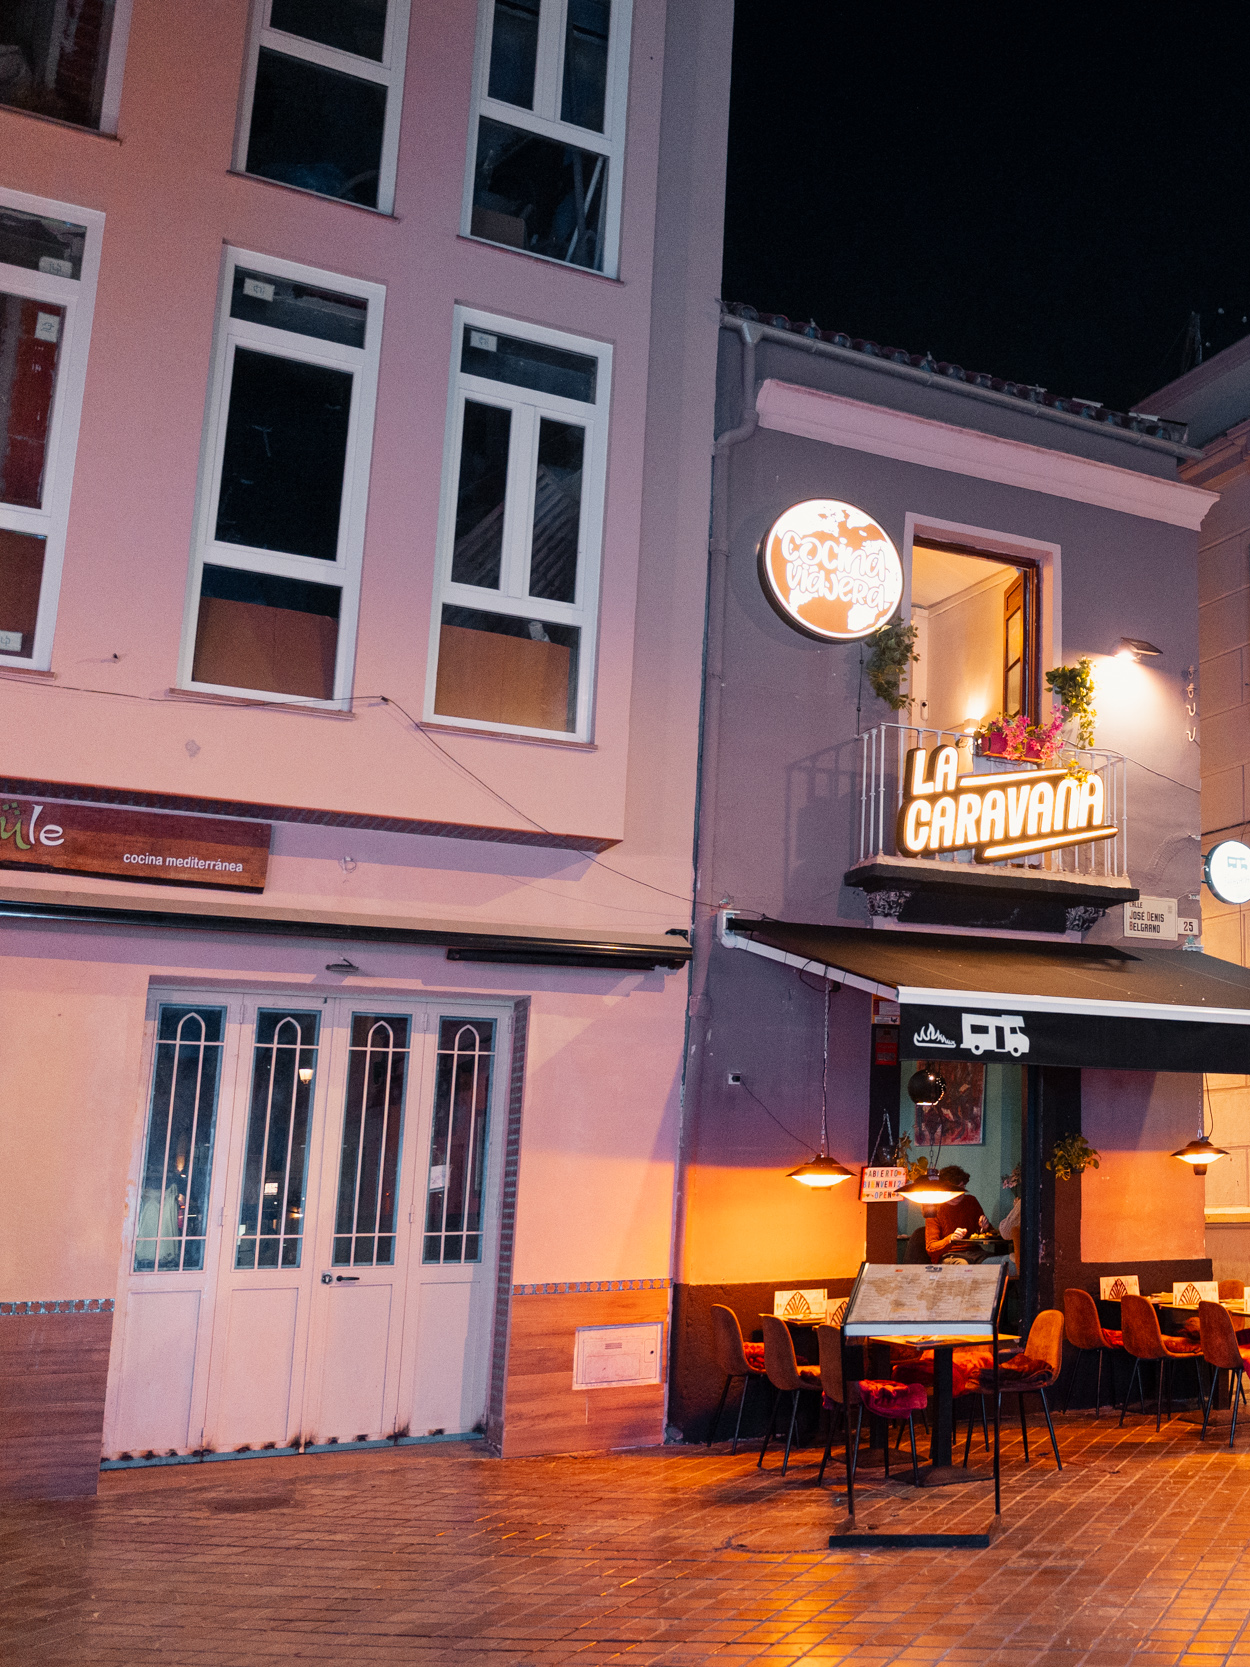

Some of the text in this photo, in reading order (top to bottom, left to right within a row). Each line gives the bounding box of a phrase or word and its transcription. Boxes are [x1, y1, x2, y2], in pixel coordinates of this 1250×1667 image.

[912, 745, 959, 796] LA
[905, 772, 1104, 851] CARAVANA
[123, 852, 244, 873] cocina mediterránea
[1129, 911, 1164, 923] JOSÉ DENIS
[1129, 921, 1161, 934] BELGRANO
[1183, 921, 1194, 932] 25
[868, 1169, 898, 1178] ABIERTO
[874, 1191, 892, 1199] OPEN
